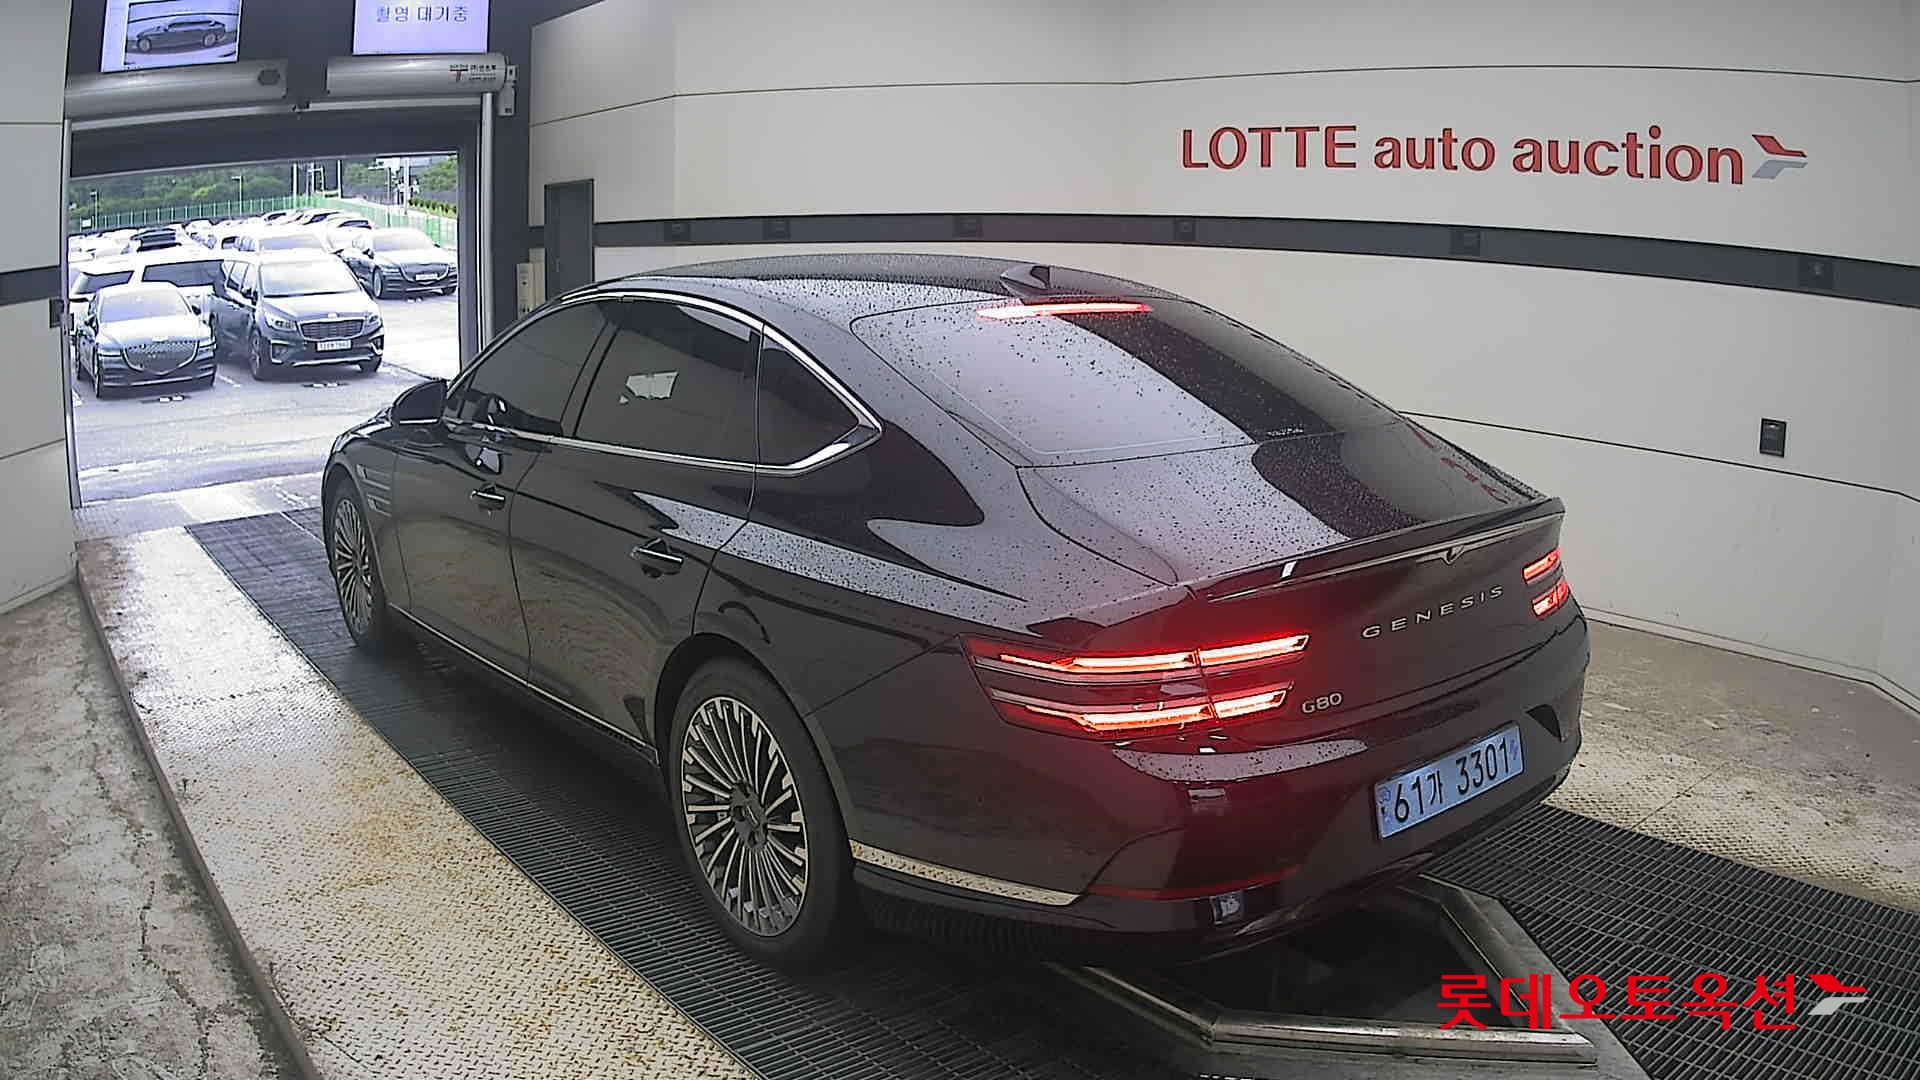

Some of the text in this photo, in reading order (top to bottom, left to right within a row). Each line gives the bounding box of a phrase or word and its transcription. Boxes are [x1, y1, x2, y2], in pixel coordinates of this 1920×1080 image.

[417, 5, 470, 23] 대기중
[1182, 125, 1743, 185] LOTTE auto auction
[1362, 586, 1503, 638] GENESIS
[1302, 693, 1343, 714] G80
[1394, 737, 1509, 823] 61가 3301
